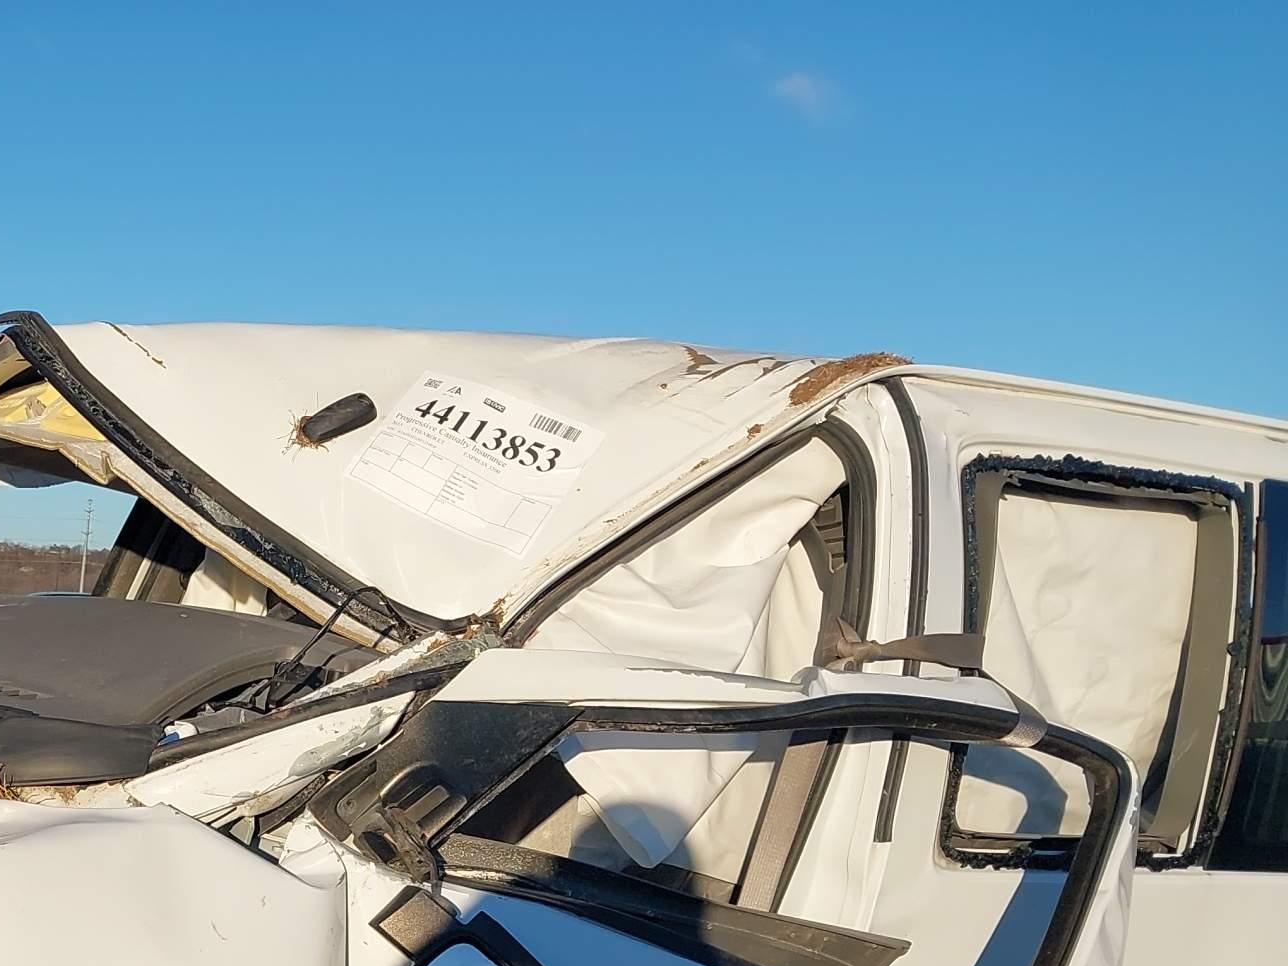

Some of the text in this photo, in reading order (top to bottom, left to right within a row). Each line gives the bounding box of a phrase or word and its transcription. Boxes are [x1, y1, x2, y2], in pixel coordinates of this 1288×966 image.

[395, 411, 438, 432] Progressive
[439, 427, 470, 449] Casualty
[471, 444, 508, 468] Insurance
[414, 399, 561, 473] 44113853
